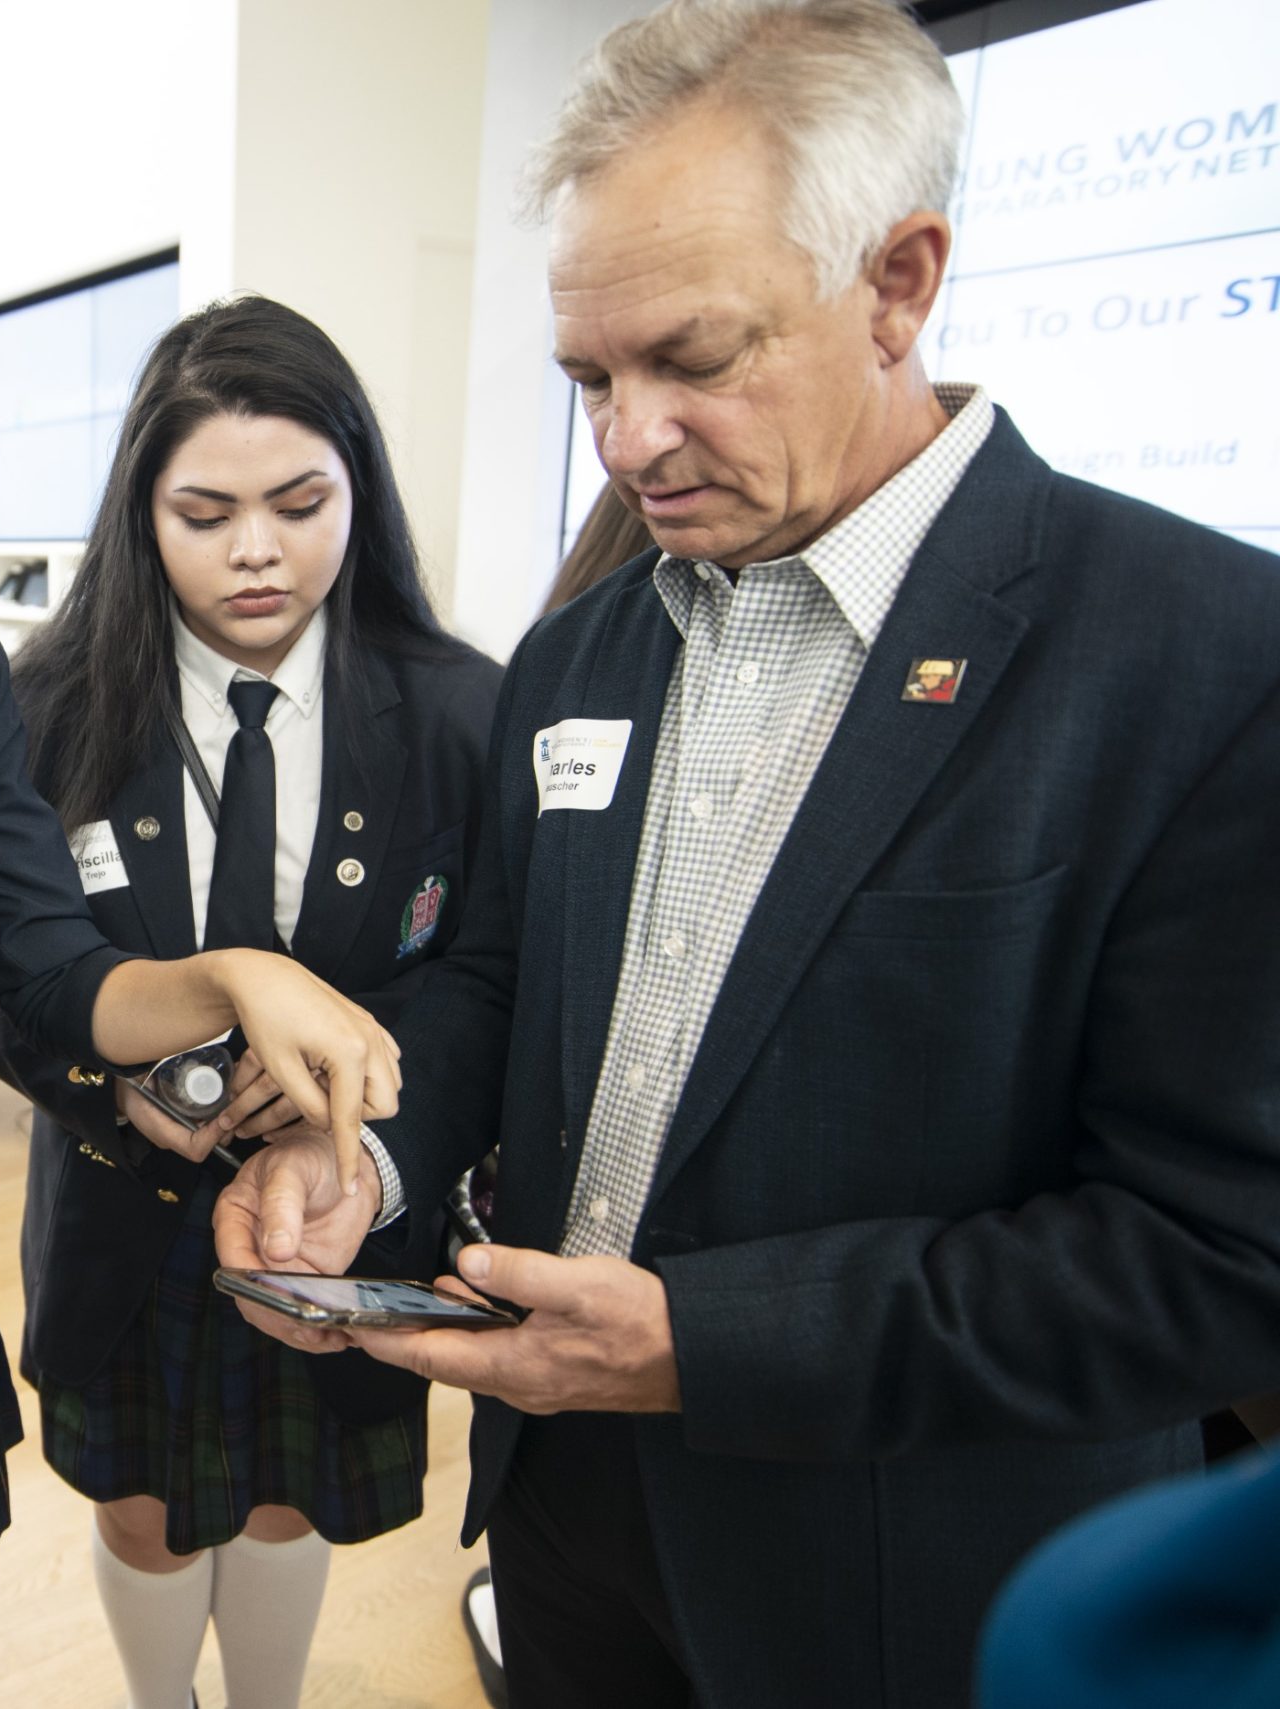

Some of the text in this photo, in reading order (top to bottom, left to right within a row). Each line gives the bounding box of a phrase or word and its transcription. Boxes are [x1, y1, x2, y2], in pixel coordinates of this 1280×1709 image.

[959, 101, 1278, 192] UNG WOM
[958, 142, 1280, 220] PARATORY NET
[1014, 302, 1071, 340] To
[1091, 293, 1201, 332] Our
[1219, 274, 1280, 318] ST
[1138, 437, 1241, 469] Build
[78, 848, 121, 869] iscilla
[85, 870, 106, 880] Trejo
